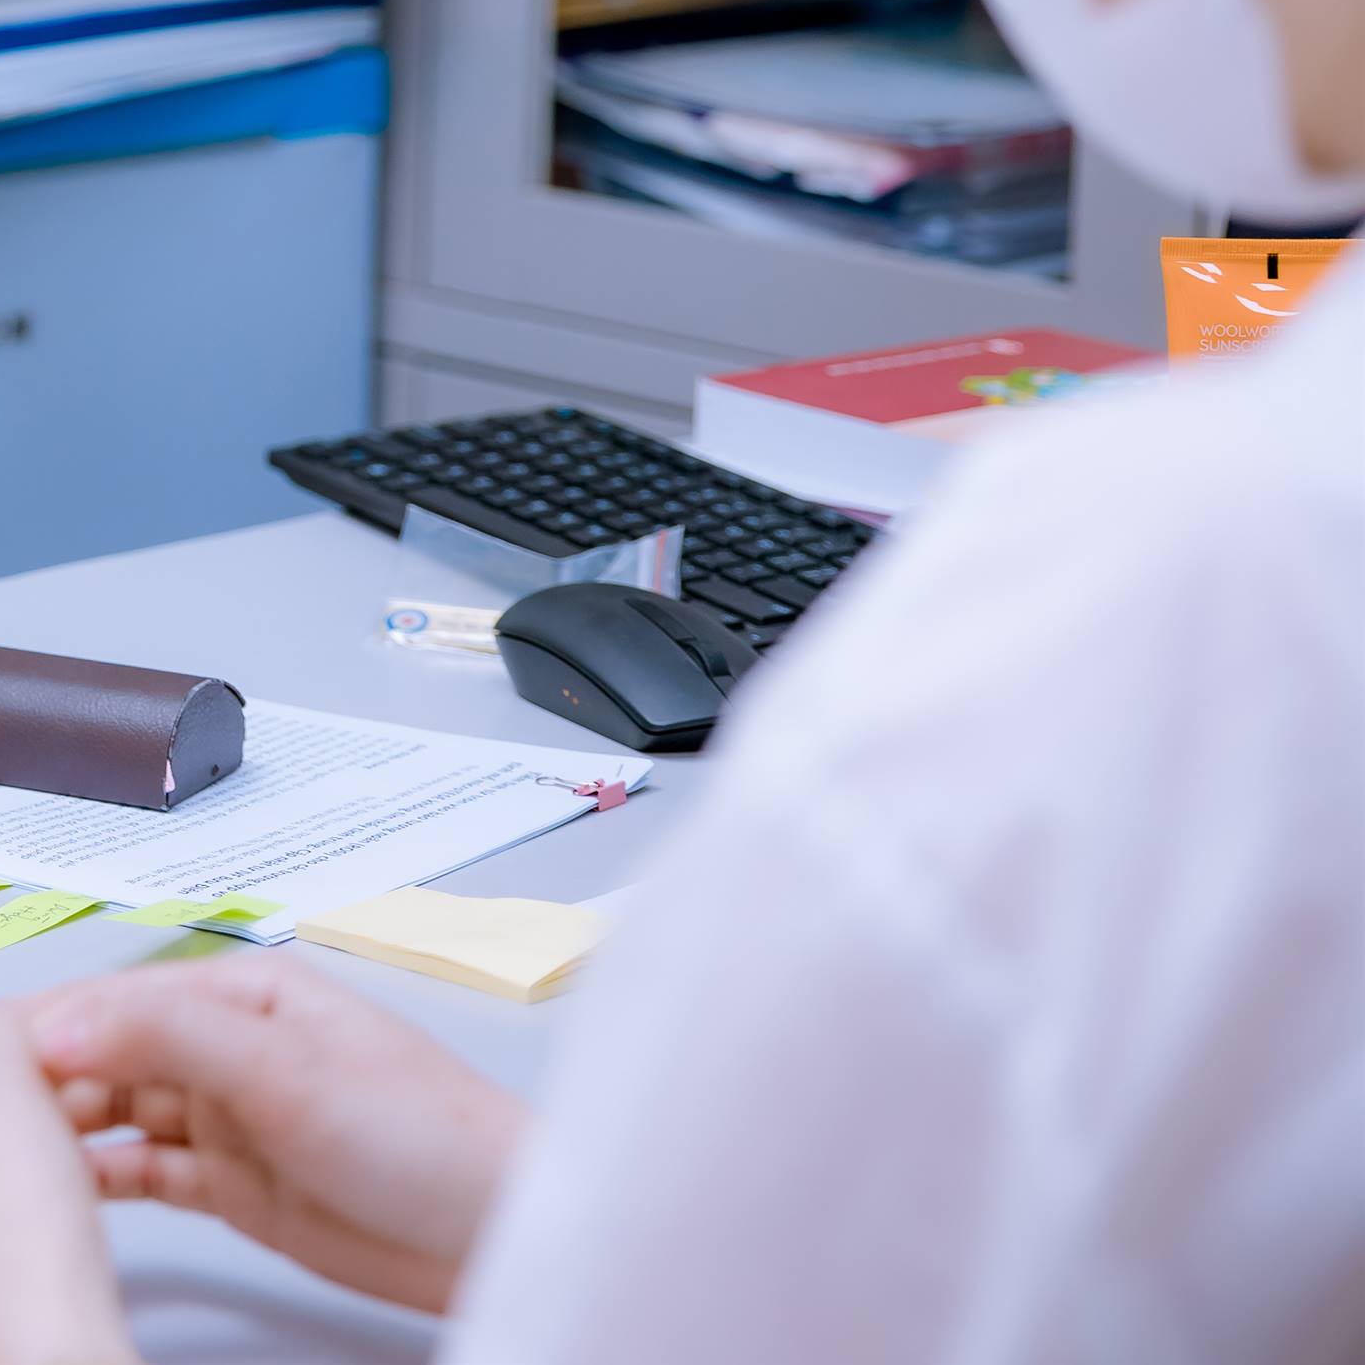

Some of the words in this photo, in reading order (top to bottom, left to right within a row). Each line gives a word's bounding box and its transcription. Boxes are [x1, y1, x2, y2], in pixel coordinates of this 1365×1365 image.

[282, 847, 313, 858] Cập
[258, 855, 291, 867] nhật
[305, 855, 332, 865] cho
[286, 863, 312, 872] các
[204, 875, 234, 885] Bưu
[173, 882, 210, 895] Điện
